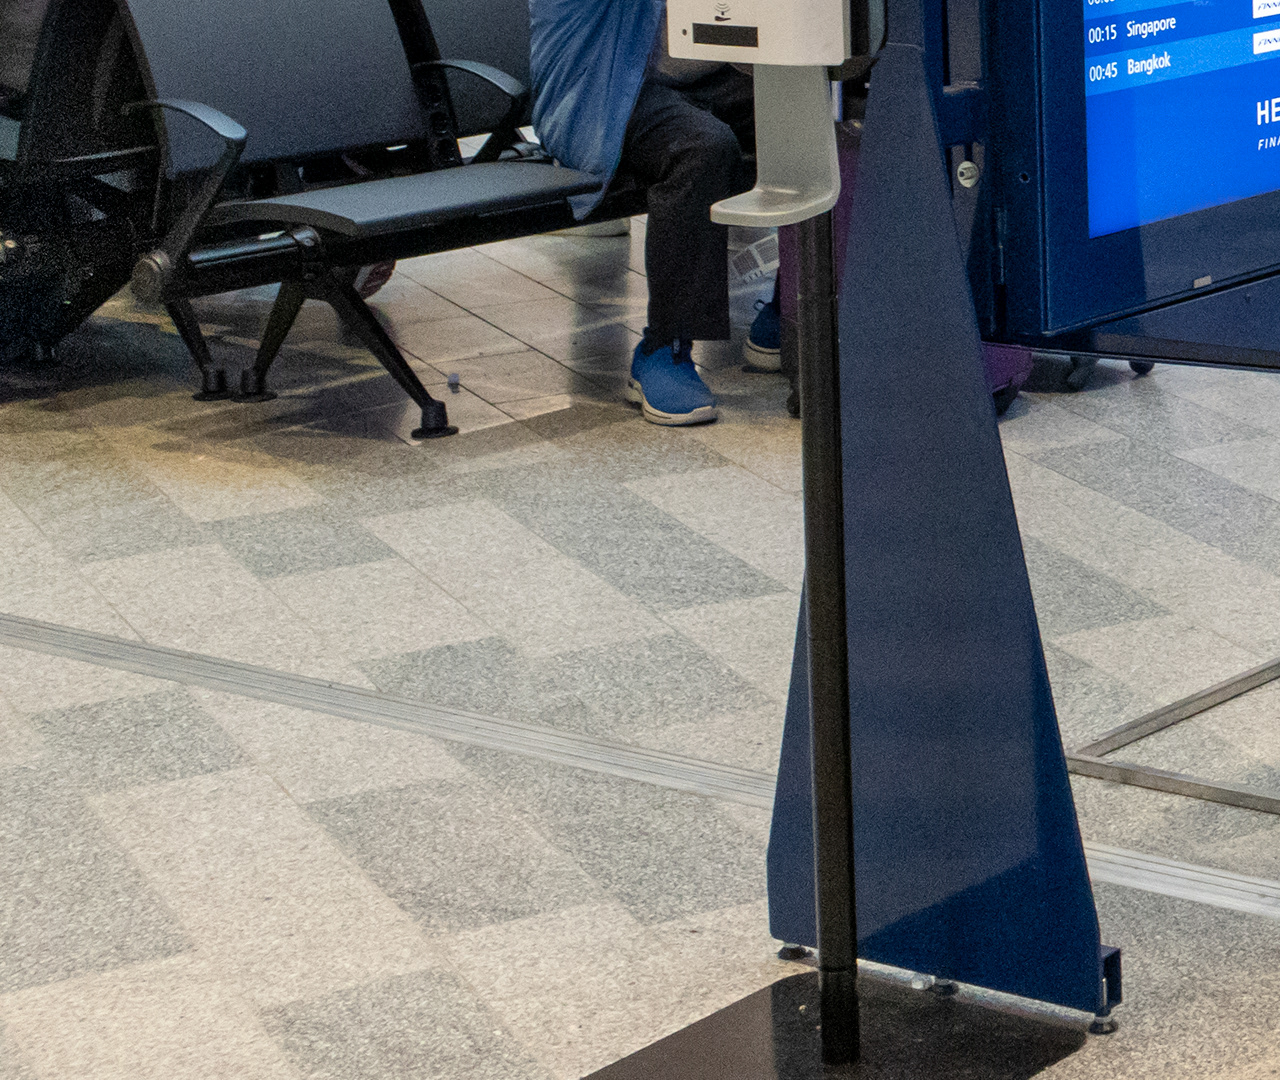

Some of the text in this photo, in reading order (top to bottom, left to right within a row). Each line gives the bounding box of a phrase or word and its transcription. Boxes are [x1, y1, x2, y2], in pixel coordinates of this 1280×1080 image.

[1088, 17, 1177, 44] 00:15 Singapore
[1127, 51, 1172, 76] Bangkok
